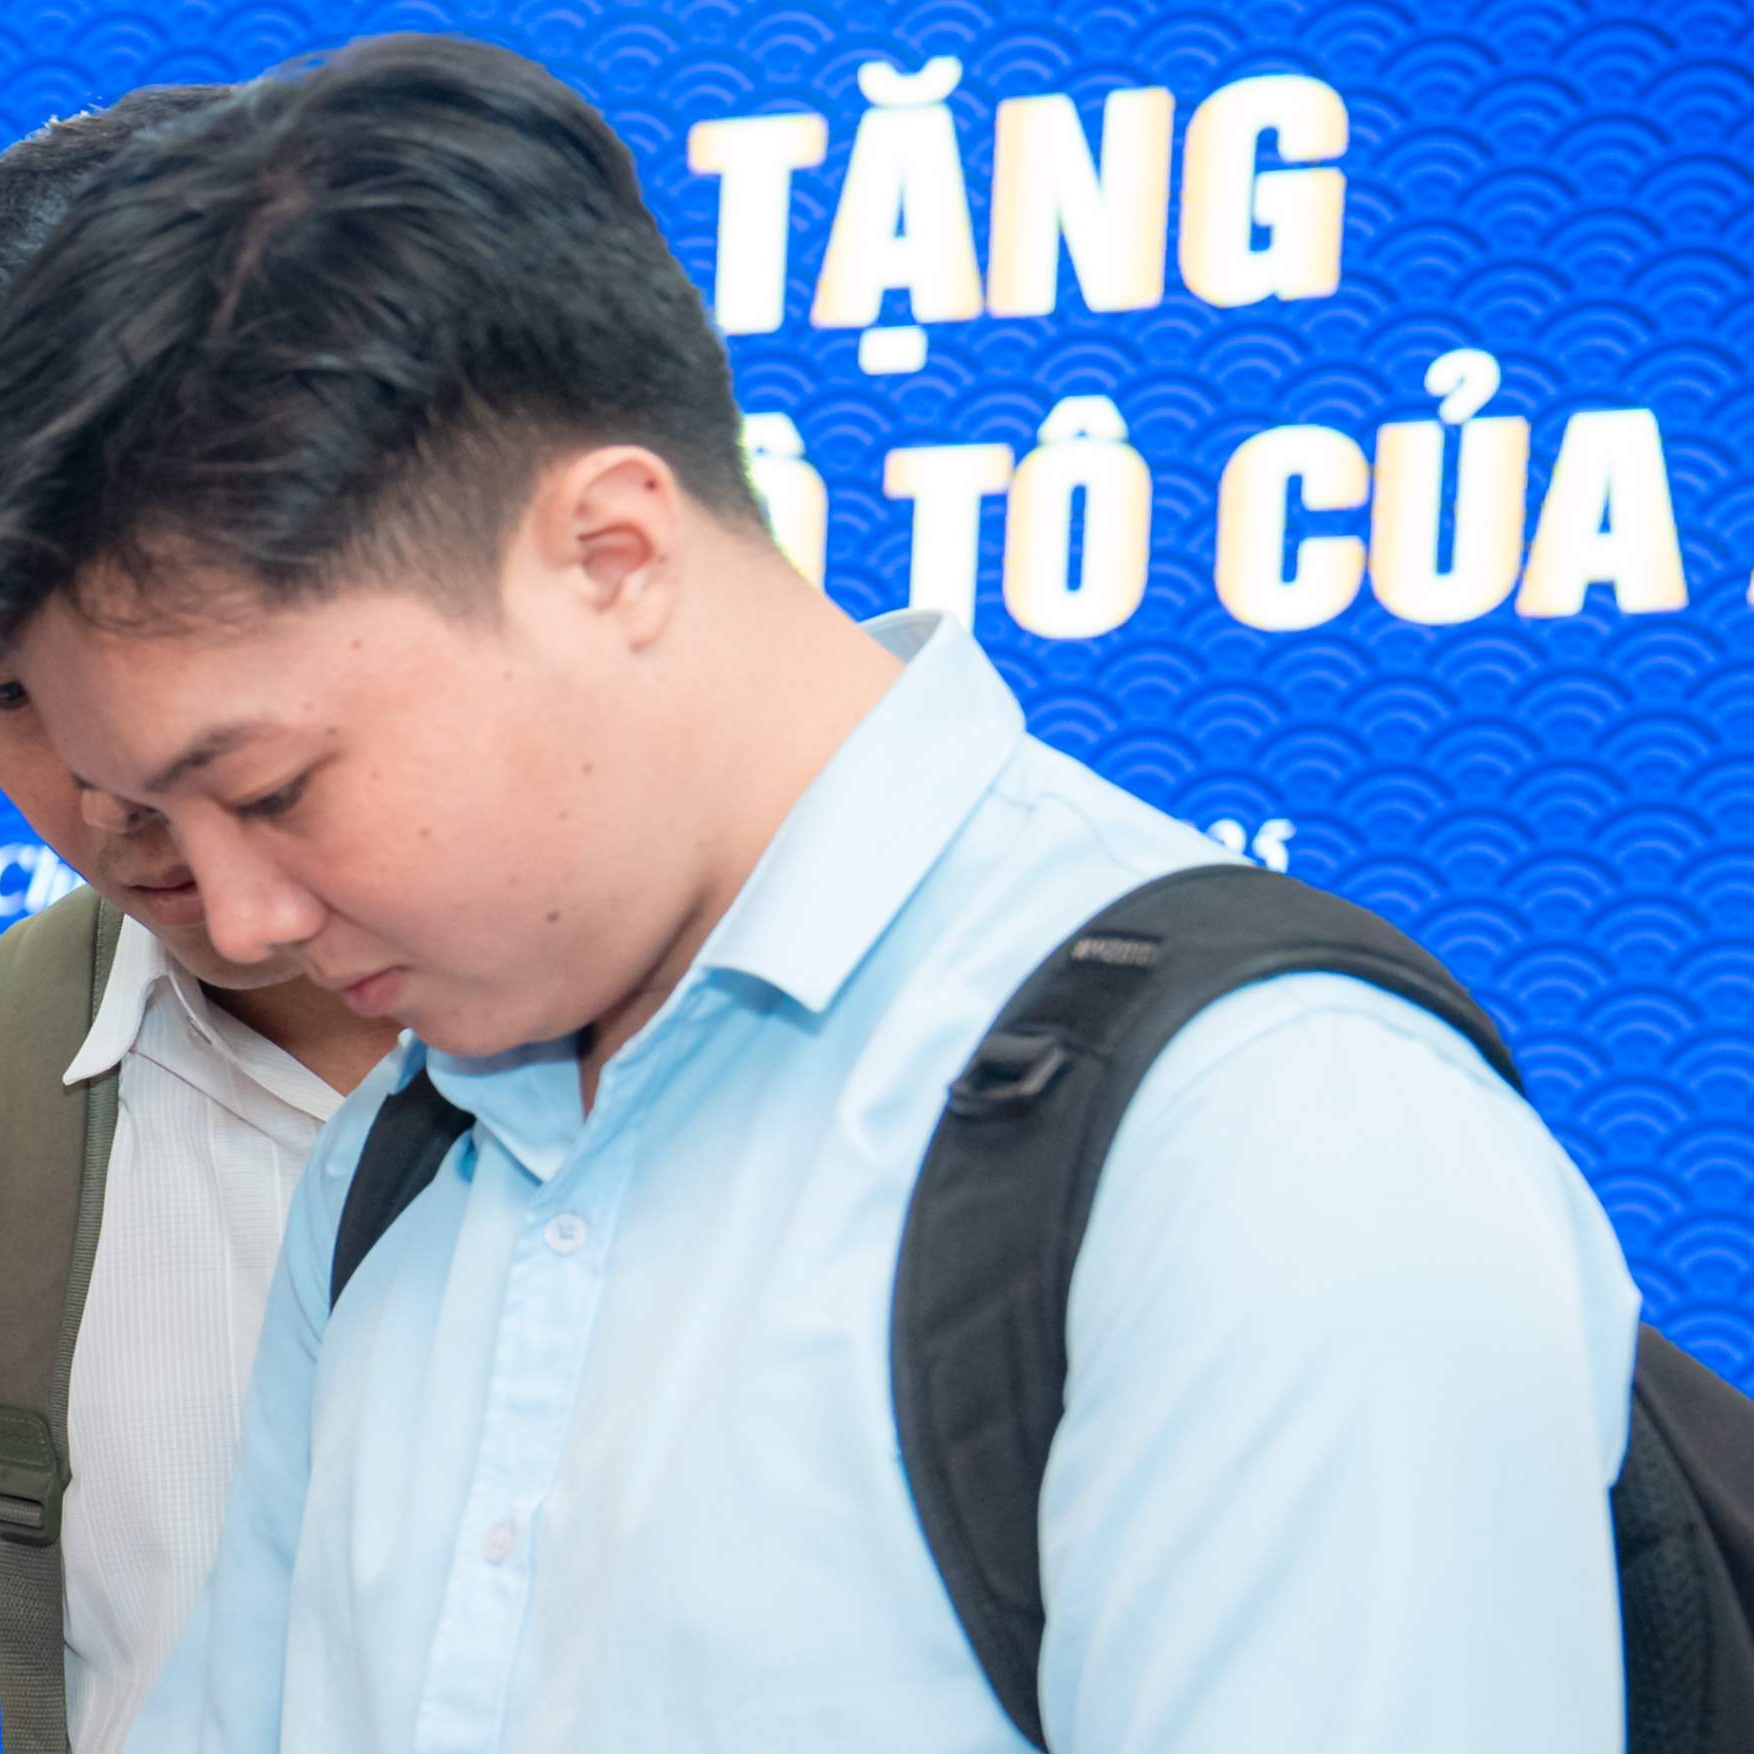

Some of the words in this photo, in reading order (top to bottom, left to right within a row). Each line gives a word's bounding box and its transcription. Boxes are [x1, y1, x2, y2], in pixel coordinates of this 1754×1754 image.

[686, 55, 1350, 376] TẶNG
[884, 395, 1153, 639] TÔ
[1214, 348, 1690, 631] CỦA
